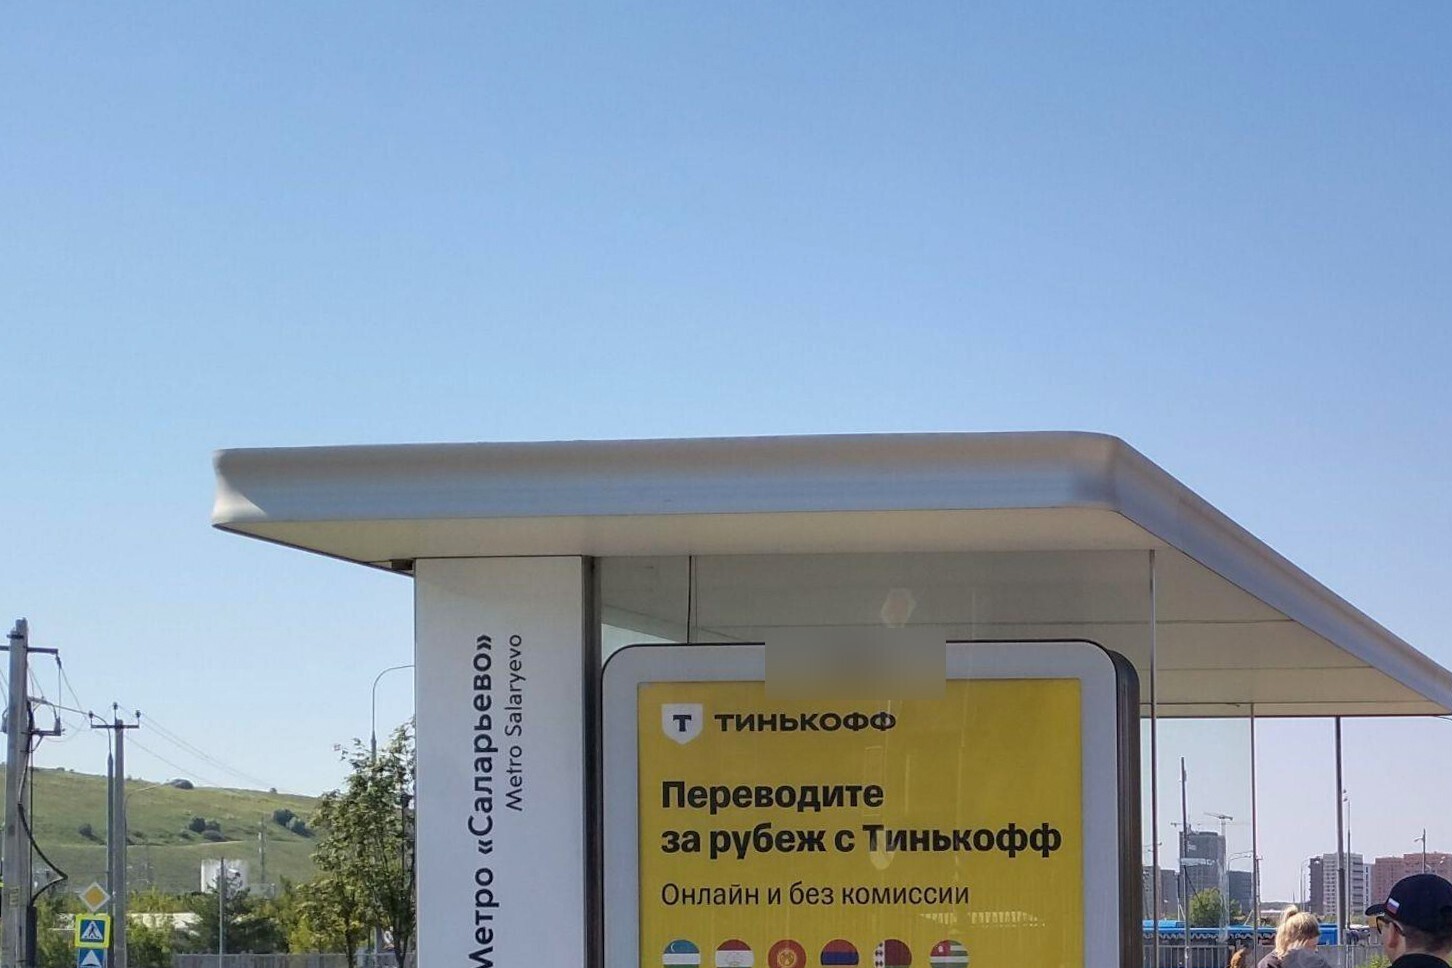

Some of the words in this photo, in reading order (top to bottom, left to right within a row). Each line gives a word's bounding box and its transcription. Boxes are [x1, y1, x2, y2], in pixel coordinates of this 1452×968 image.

[504, 633, 527, 737] Salaryevo
[713, 711, 897, 732] ТИНЬКОФФ
[467, 633, 499, 856] «Саларьево»
[505, 744, 523, 812] Metro
[661, 780, 885, 816] Переводите
[660, 829, 702, 853] за
[709, 821, 827, 860] рубеж
[834, 829, 856, 853] с
[862, 822, 1063, 858] Тинькофф
[661, 881, 760, 906] Онлайн
[767, 887, 782, 905] и
[789, 880, 835, 906] без
[841, 886, 970, 905] комиссии
